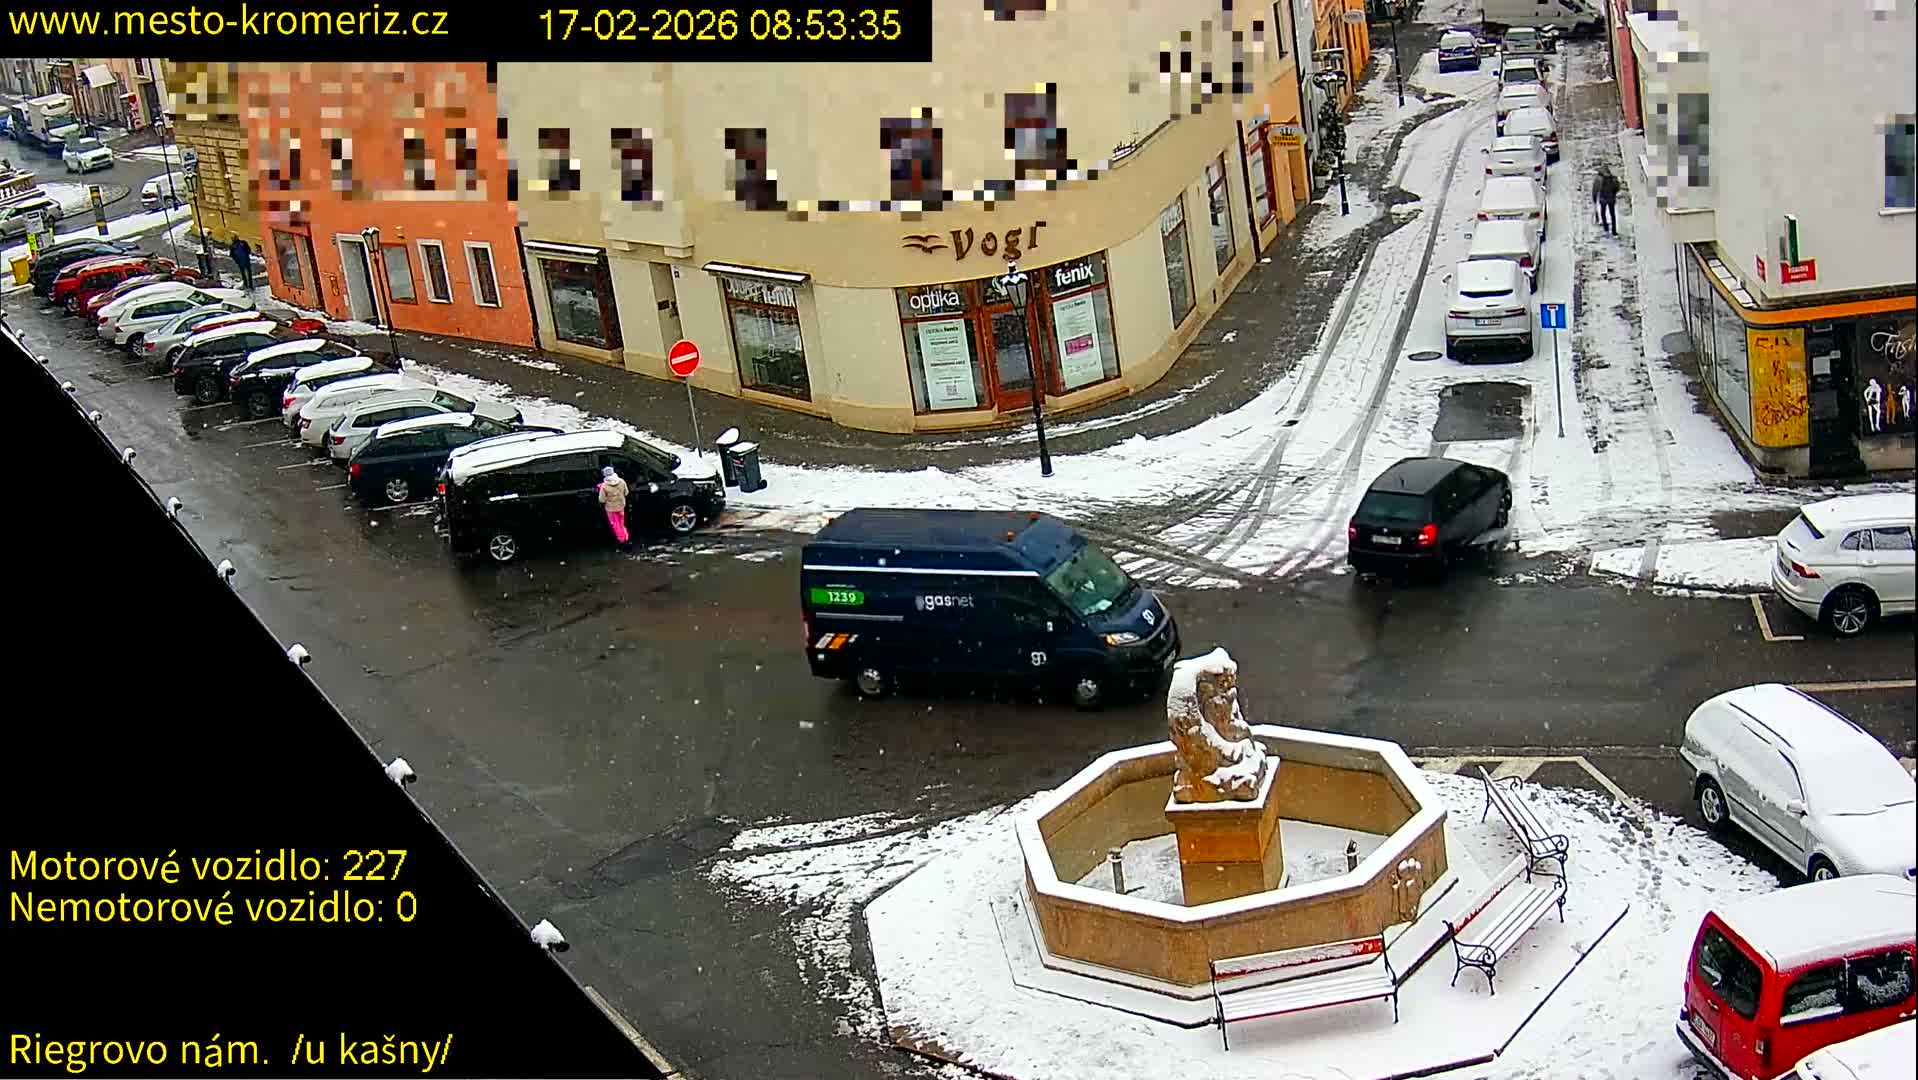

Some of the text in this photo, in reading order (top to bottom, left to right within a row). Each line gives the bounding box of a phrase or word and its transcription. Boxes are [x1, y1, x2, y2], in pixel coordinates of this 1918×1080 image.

[1054, 263, 1094, 287] fenix
[910, 288, 960, 313] optika
[827, 590, 857, 604] 1239
[924, 593, 975, 611] gasnet
